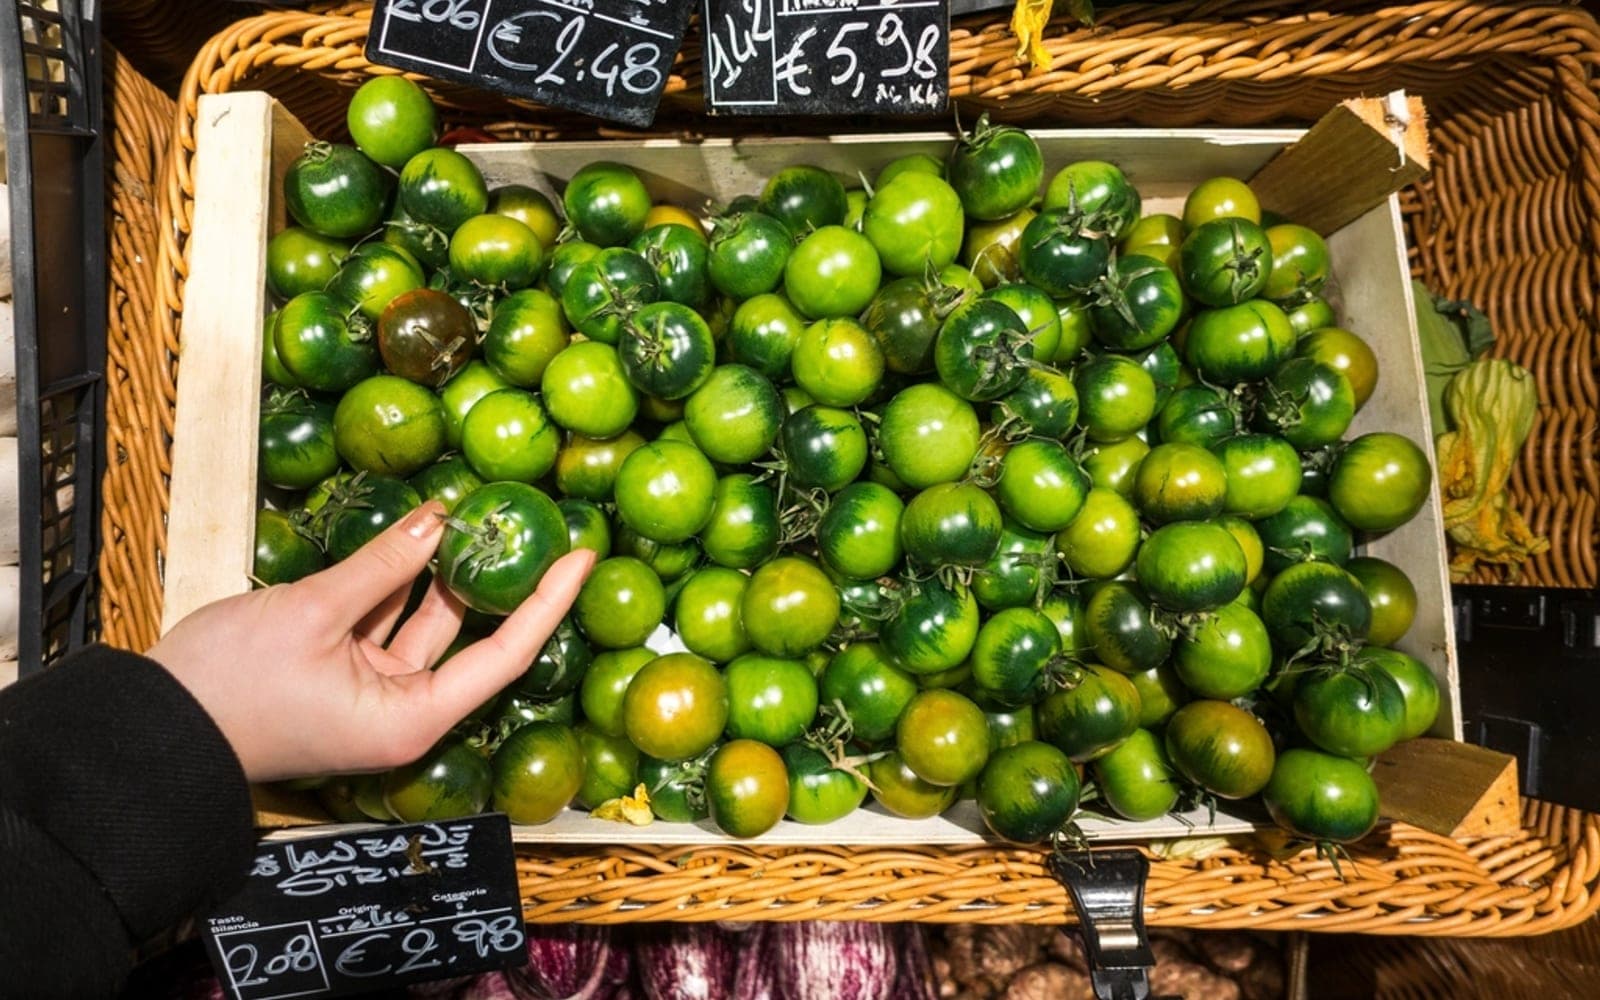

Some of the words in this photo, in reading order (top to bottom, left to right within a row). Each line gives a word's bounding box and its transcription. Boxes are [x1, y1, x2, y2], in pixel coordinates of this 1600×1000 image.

[432, 887, 487, 902] Categoria
[338, 903, 382, 916] Origine
[208, 915, 244, 926] Tasto
[210, 920, 260, 934] Bilancia
[226, 934, 317, 989] 208
